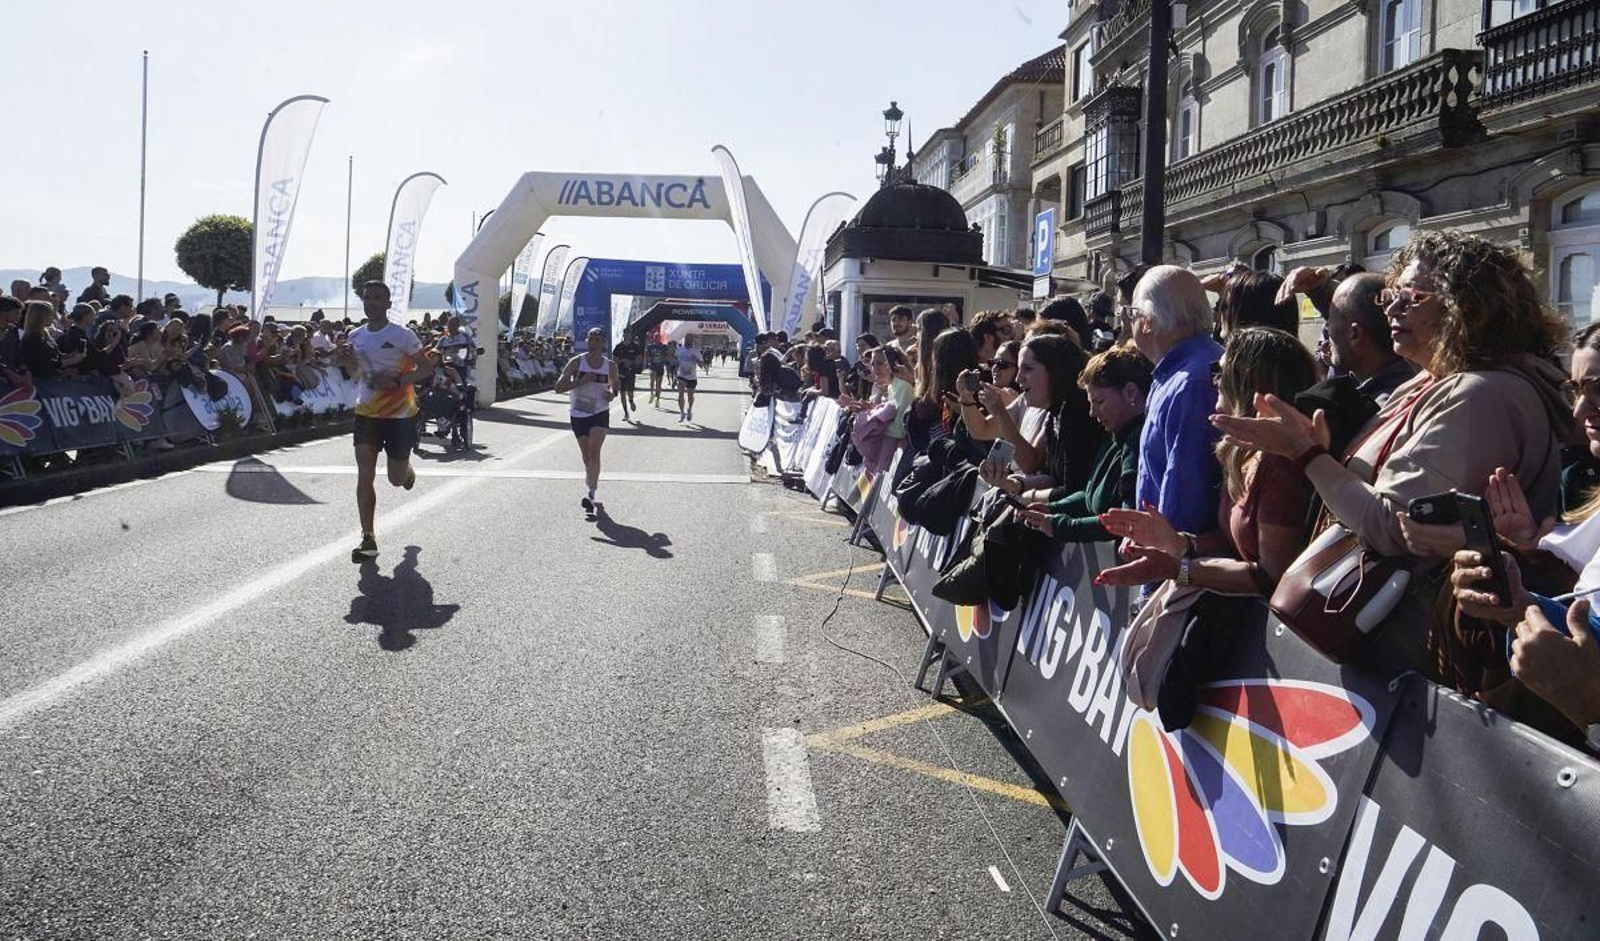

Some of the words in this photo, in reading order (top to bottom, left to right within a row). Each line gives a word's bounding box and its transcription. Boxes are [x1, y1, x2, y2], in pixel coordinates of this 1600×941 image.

[1036, 218, 1049, 268] P
[669, 268, 705, 279] XUNTA
[668, 279, 682, 289] DE
[684, 280, 728, 290] GALICIA
